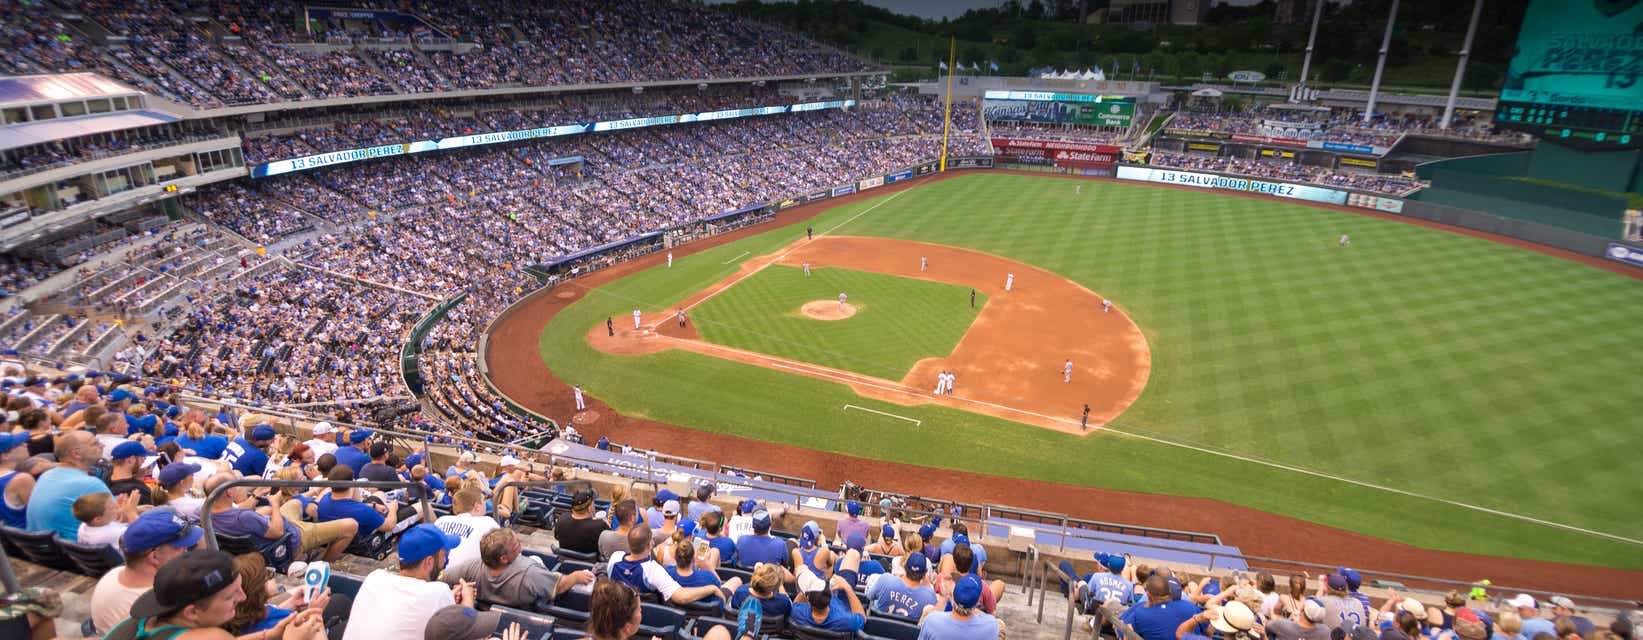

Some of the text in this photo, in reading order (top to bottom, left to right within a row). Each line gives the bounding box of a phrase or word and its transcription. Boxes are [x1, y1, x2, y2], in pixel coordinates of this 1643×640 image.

[471, 126, 558, 145] 13 SALVADOR PEREZ
[290, 144, 403, 170] 13 SALVADOR PEREZ
[1160, 172, 1295, 196] 13 SALVADOR PEREZ
[890, 590, 919, 610] PEREZ
